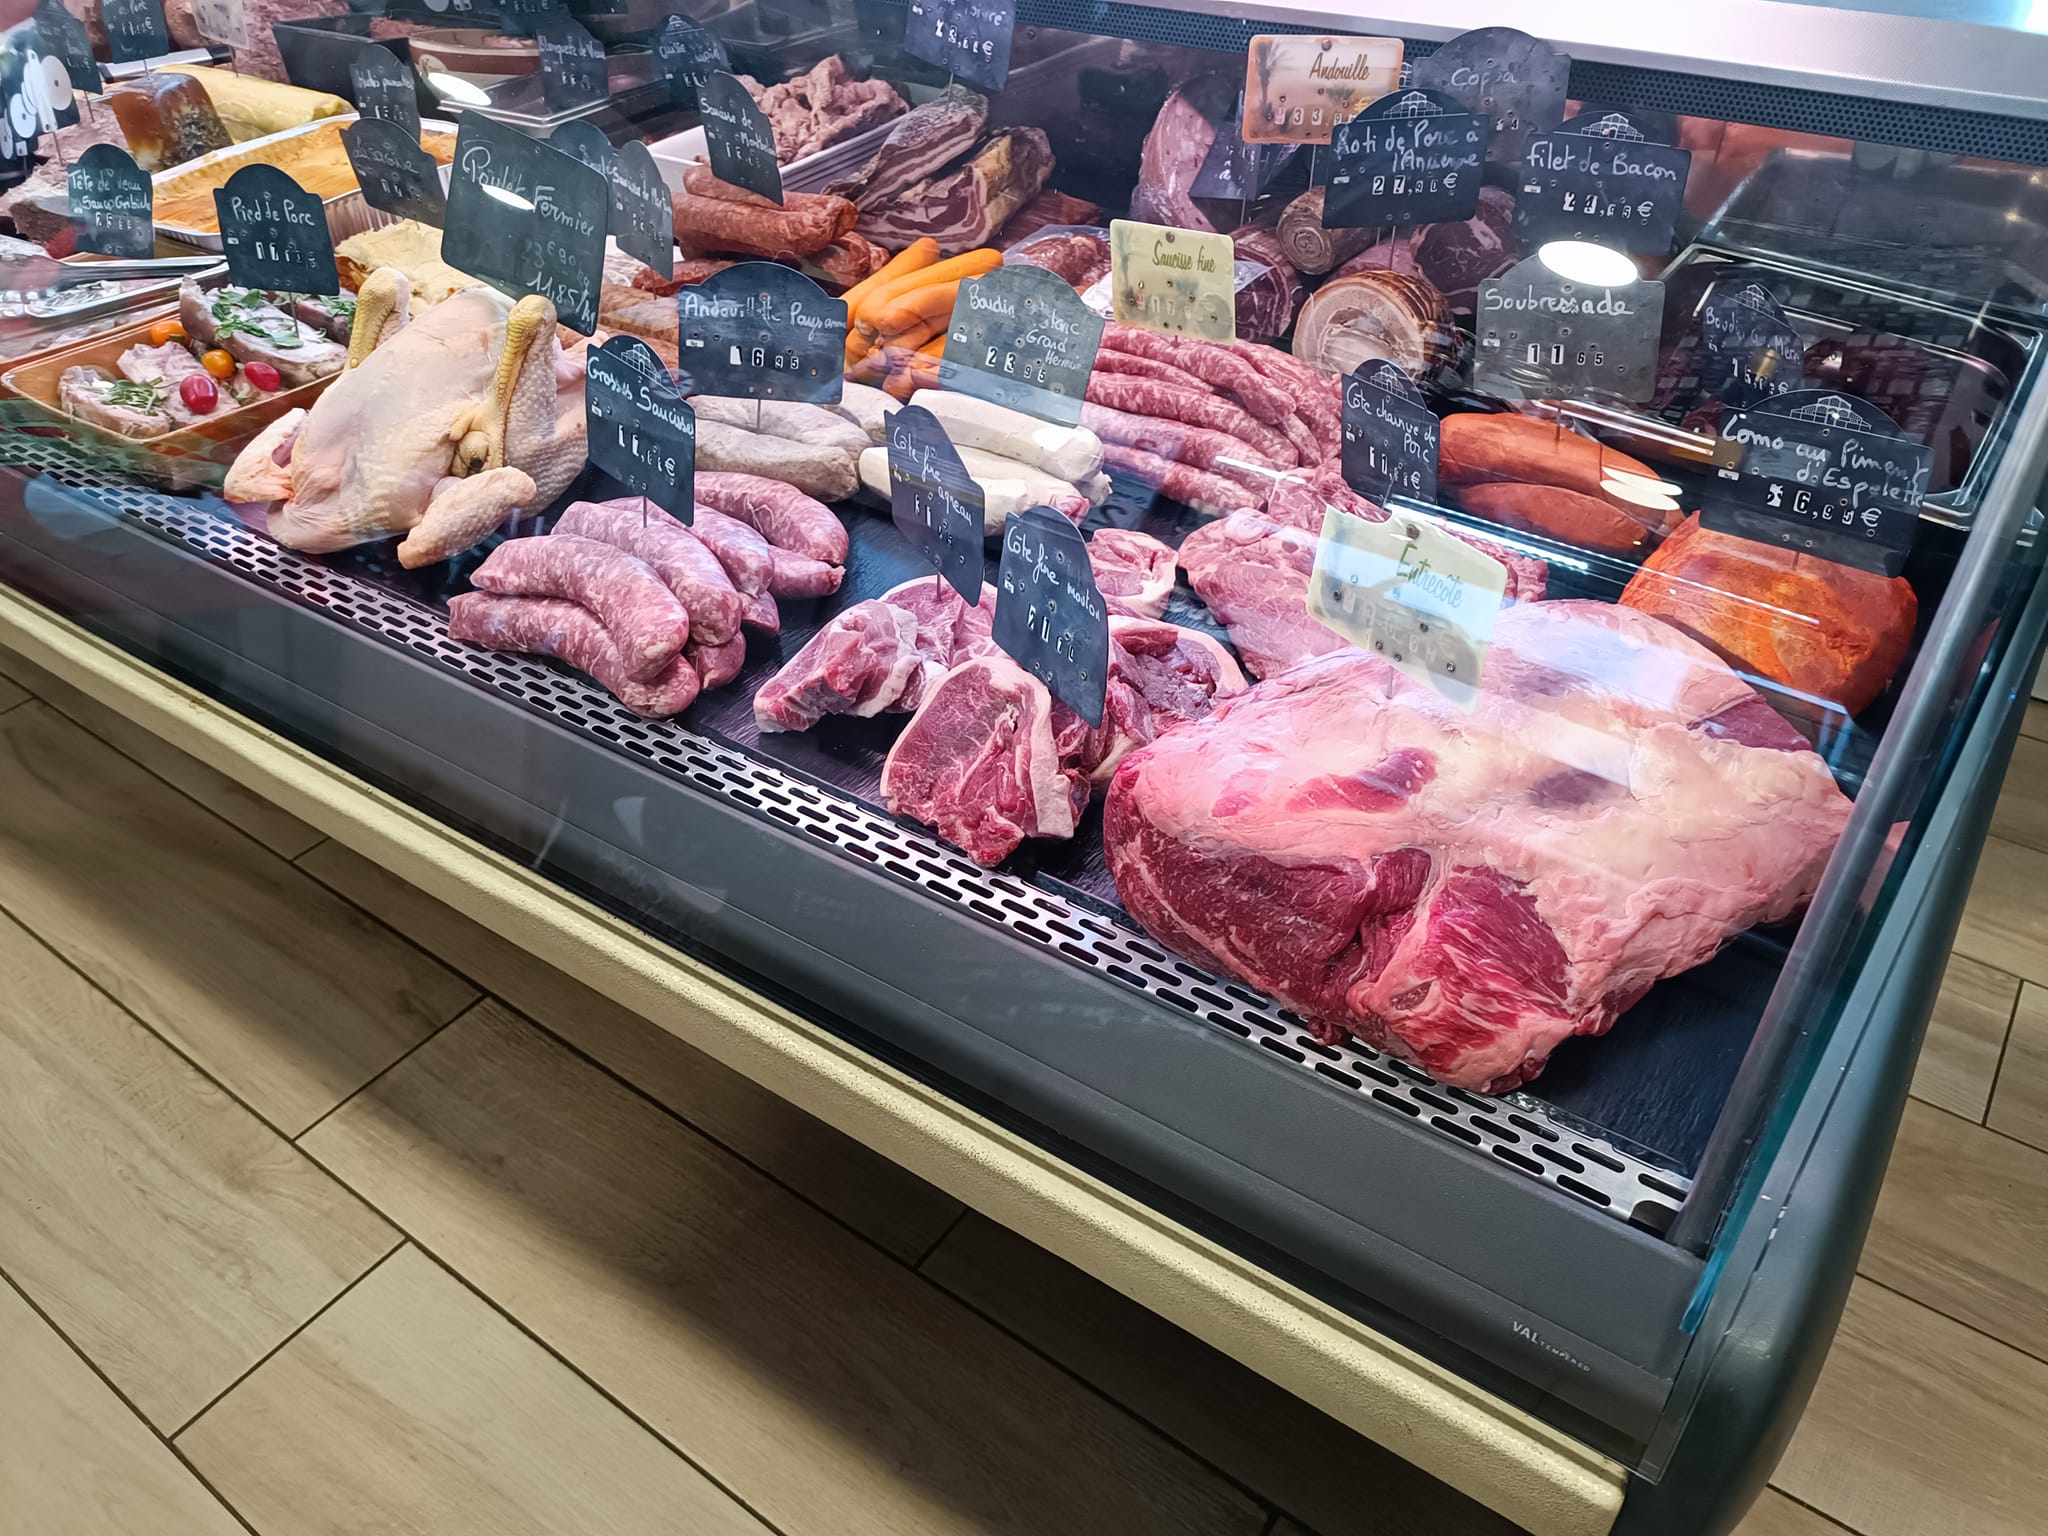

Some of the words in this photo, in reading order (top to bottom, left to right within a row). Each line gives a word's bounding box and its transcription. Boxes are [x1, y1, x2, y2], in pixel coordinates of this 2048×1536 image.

[1309, 52, 1370, 81] Andouille
[1579, 146, 1601, 175] de
[1612, 152, 1678, 181] Bacon
[462, 145, 526, 192] Poulet
[532, 185, 595, 238] Fermier
[232, 197, 262, 225] Pied
[265, 198, 280, 222] de
[283, 198, 316, 226] Porc
[1152, 239, 1193, 270] Saucisse
[1196, 245, 1216, 273] fine
[969, 283, 1016, 319] Boudin
[1026, 328, 1066, 353] Grand
[1403, 432, 1430, 463] Porc
[1722, 414, 1784, 450] Lomo
[937, 486, 973, 527] agneau
[1033, 543, 1060, 586] fine
[1066, 584, 1102, 623] mouton
[1396, 541, 1463, 609] Entrecôte
